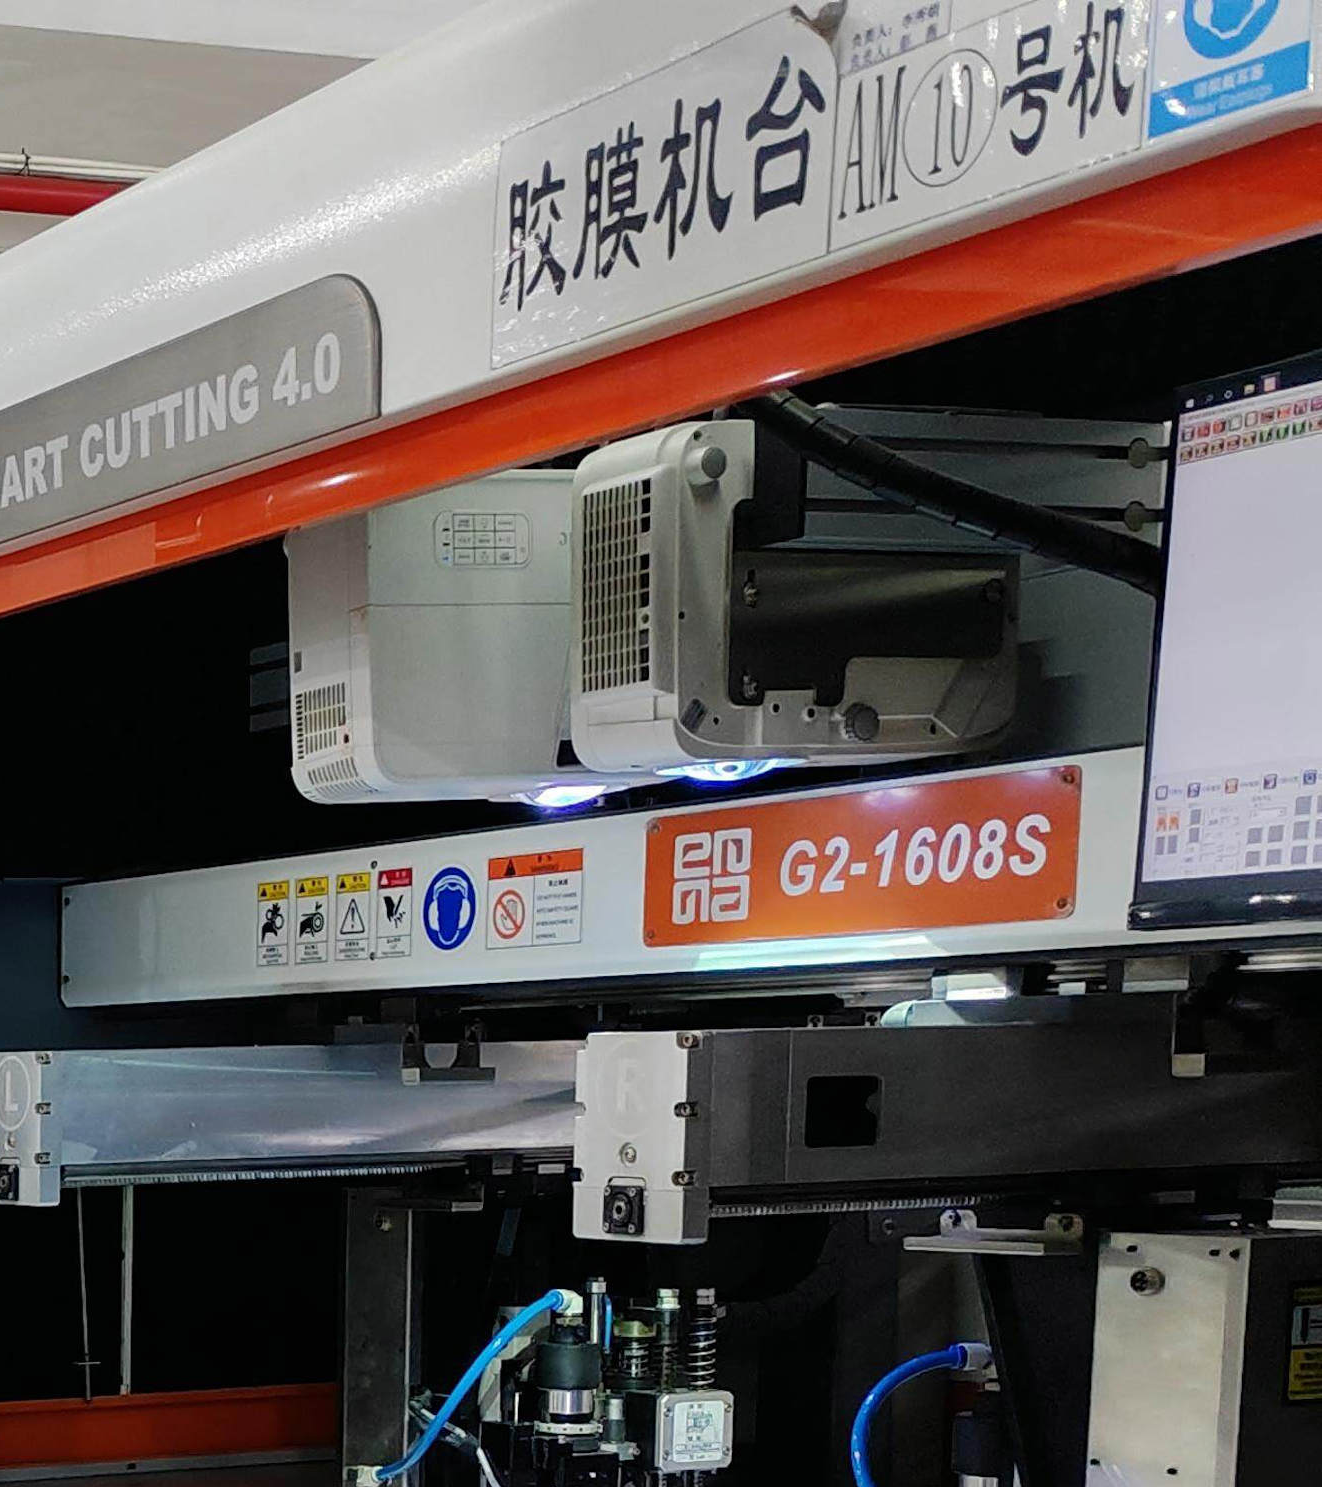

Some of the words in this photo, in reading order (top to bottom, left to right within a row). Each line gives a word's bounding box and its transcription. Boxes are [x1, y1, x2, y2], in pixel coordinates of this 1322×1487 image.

[499, 56, 826, 312] 胶膜机台
[80, 364, 258, 478] CUTTING
[272, 333, 341, 406] 4.0
[780, 813, 1051, 897] G2-1608S
[5, 1071, 18, 1111] L
